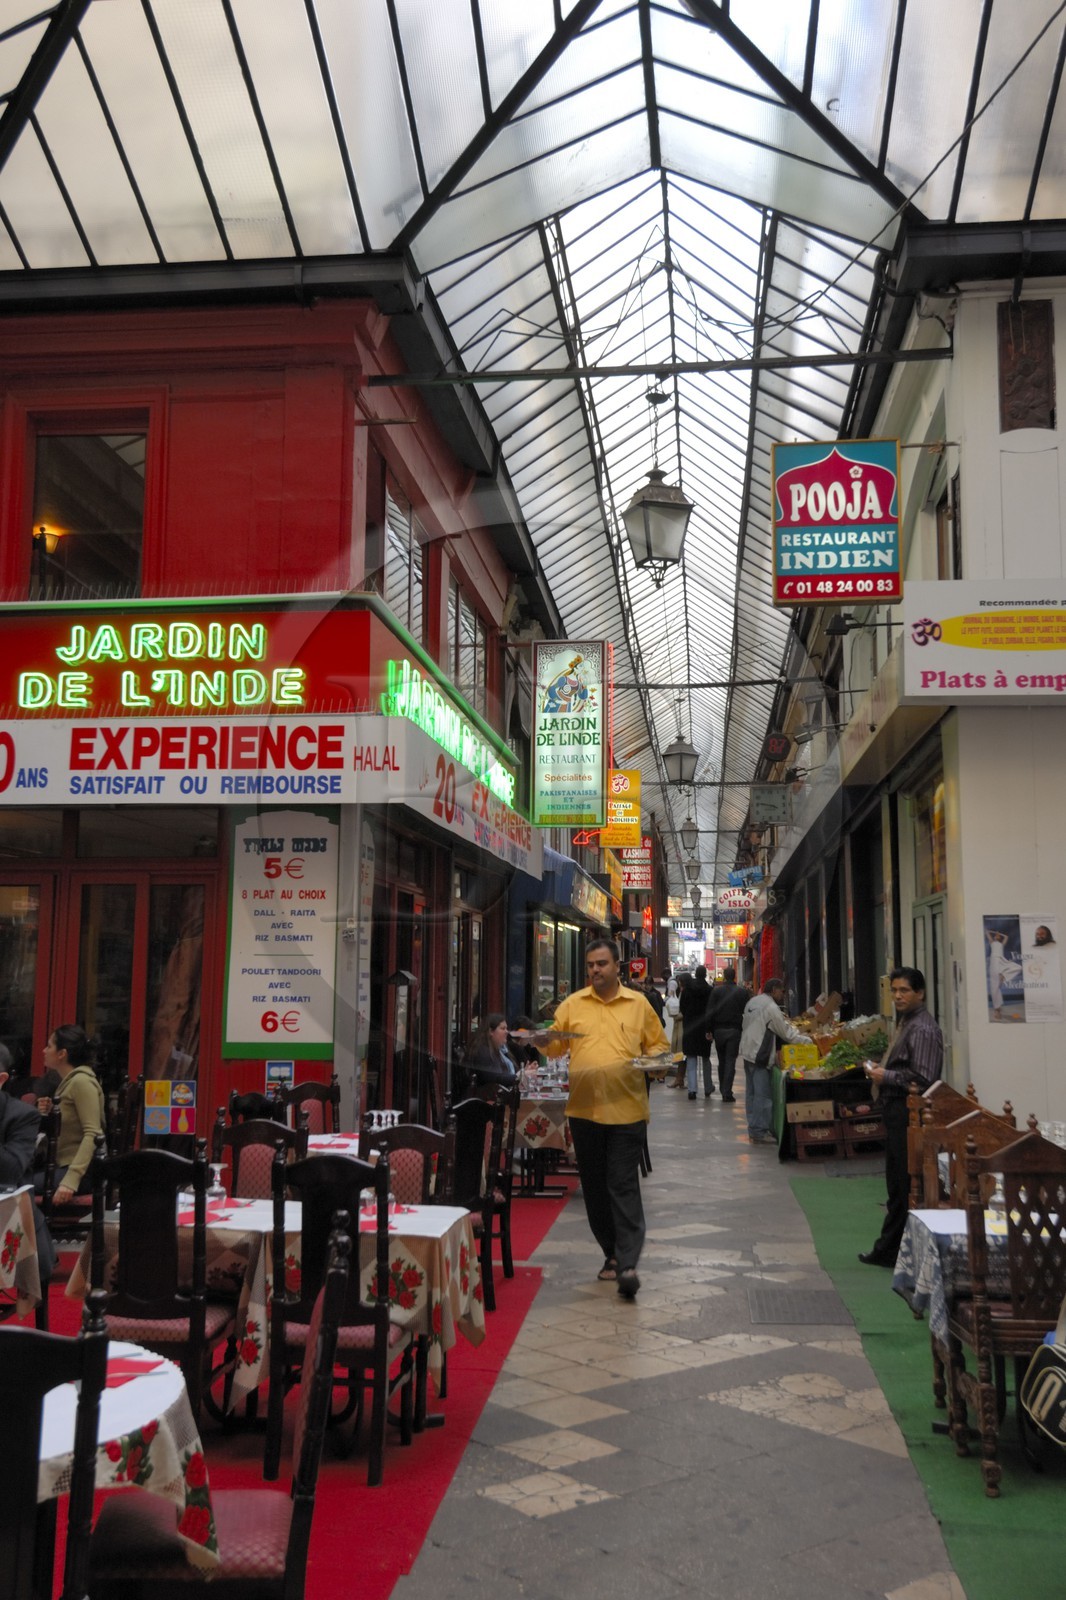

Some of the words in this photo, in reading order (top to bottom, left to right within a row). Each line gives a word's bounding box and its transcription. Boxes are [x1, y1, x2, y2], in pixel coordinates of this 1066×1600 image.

[789, 479, 883, 522] POOJA
[781, 530, 896, 547] RESTAURANT
[780, 549, 894, 570] INDIEN
[796, 580, 812, 594] 01
[816, 580, 834, 594] 48
[837, 580, 853, 593] 24
[856, 580, 873, 593] 00
[876, 579, 894, 592] 83
[979, 599, 1058, 607] Recommandée
[56, 622, 268, 662] JARDIN
[920, 671, 986, 689] Plats
[994, 670, 1008, 688] à
[18, 671, 93, 709] DE
[120, 668, 306, 708] L'INDE
[539, 717, 597, 731] JARDIN
[536, 732, 555, 746] DE
[559, 732, 601, 746] L'INDE
[69, 725, 345, 771] EXPERIENCE
[353, 744, 400, 771] HALAL
[539, 754, 597, 764] RESTAURANT
[15, 767, 48, 789] ANS
[70, 776, 165, 794] SATISFAIT
[180, 776, 208, 794] OU
[220, 775, 342, 794] REMBOURSE
[544, 773, 592, 783] Spécialités
[433, 754, 455, 825] 20
[472, 781, 532, 851] EXERIENCE
[547, 803, 591, 811] INDIENNES
[622, 848, 651, 859] KASHMIR
[263, 857, 305, 879] 5€
[630, 873, 651, 881] INDIEN
[242, 890, 248, 899] 8
[253, 890, 275, 899] PLAT
[280, 890, 293, 899] AU
[298, 890, 326, 900] CHOIX
[718, 888, 759, 904] COIFFRE
[254, 909, 276, 917] DALL
[290, 909, 316, 917] RAITA
[255, 934, 269, 942] RIZ
[274, 934, 313, 942] BASMATI
[277, 968, 321, 976] TANDOORI
[252, 995, 267, 1003] RIZ
[272, 995, 311, 1003] BASMATI
[260, 1010, 301, 1033] 6€
